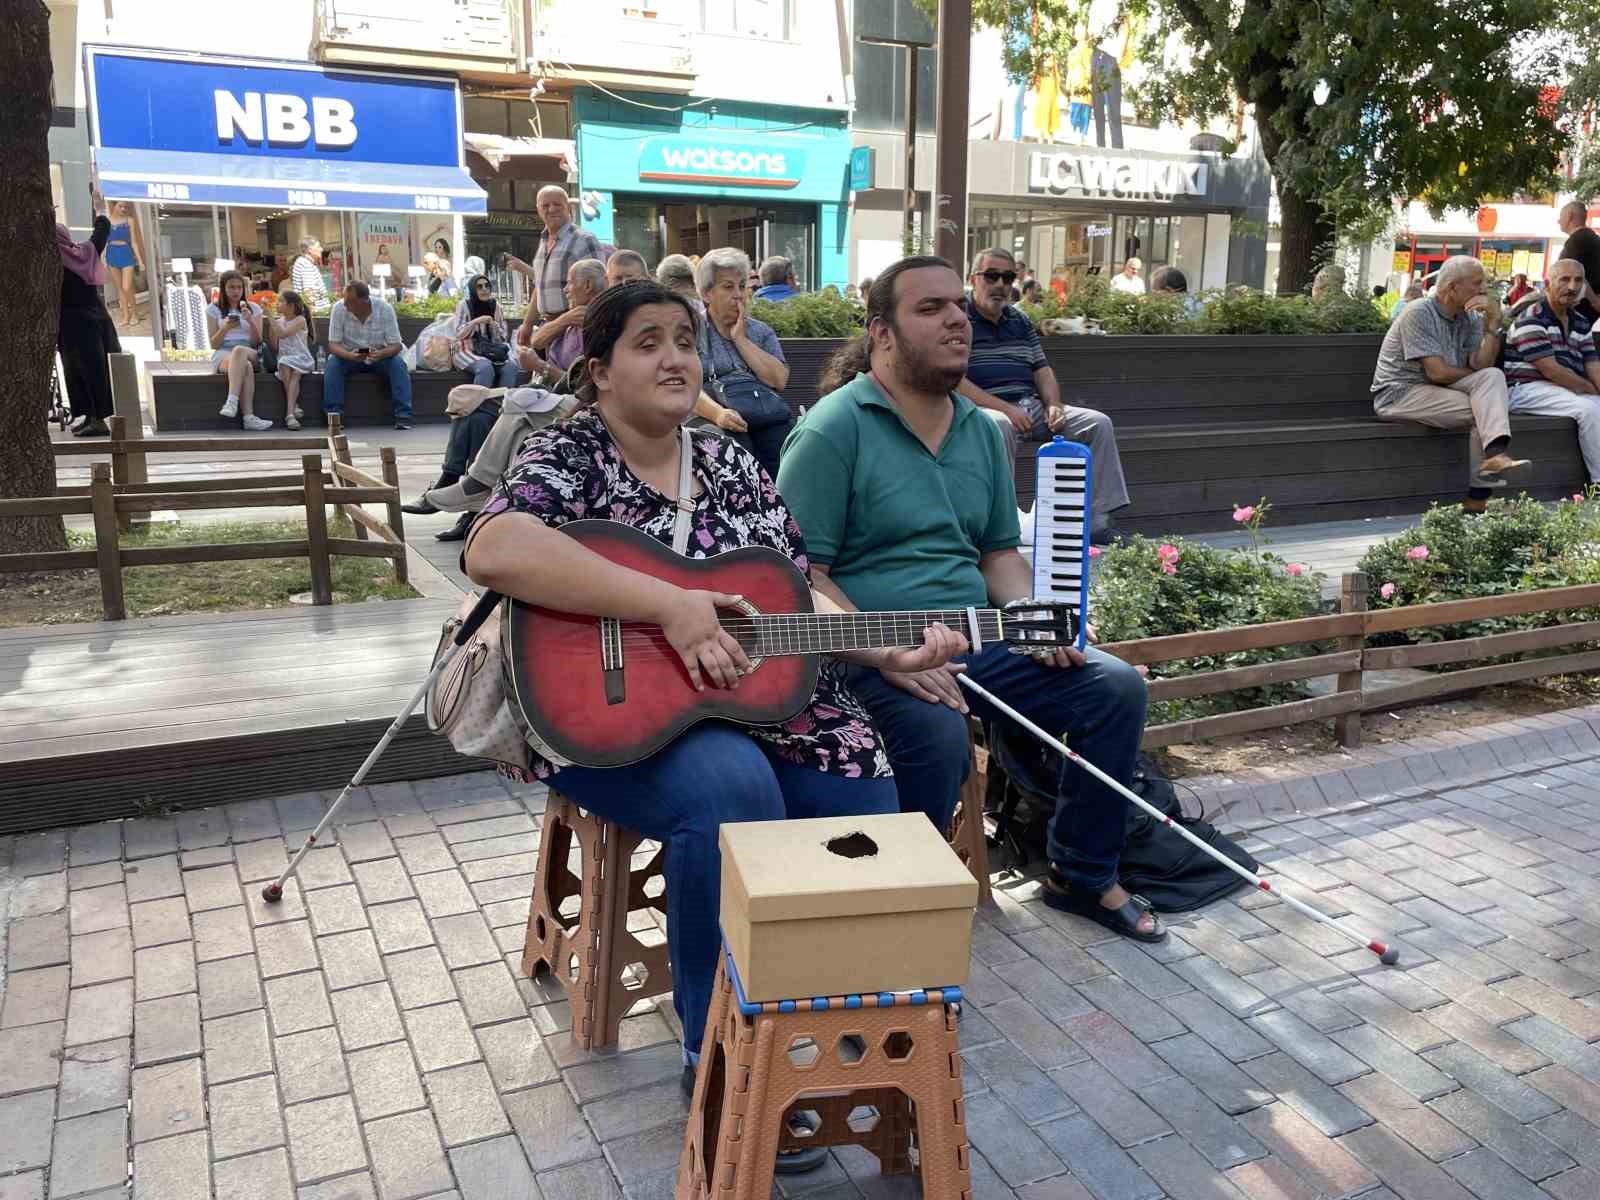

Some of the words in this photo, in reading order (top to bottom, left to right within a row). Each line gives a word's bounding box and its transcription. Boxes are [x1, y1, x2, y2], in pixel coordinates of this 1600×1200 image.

[213, 89, 358, 147] NBB
[661, 147, 787, 175] watsons
[146, 183, 190, 200] NBB
[287, 190, 327, 206] NBB
[414, 195, 450, 210] NBB
